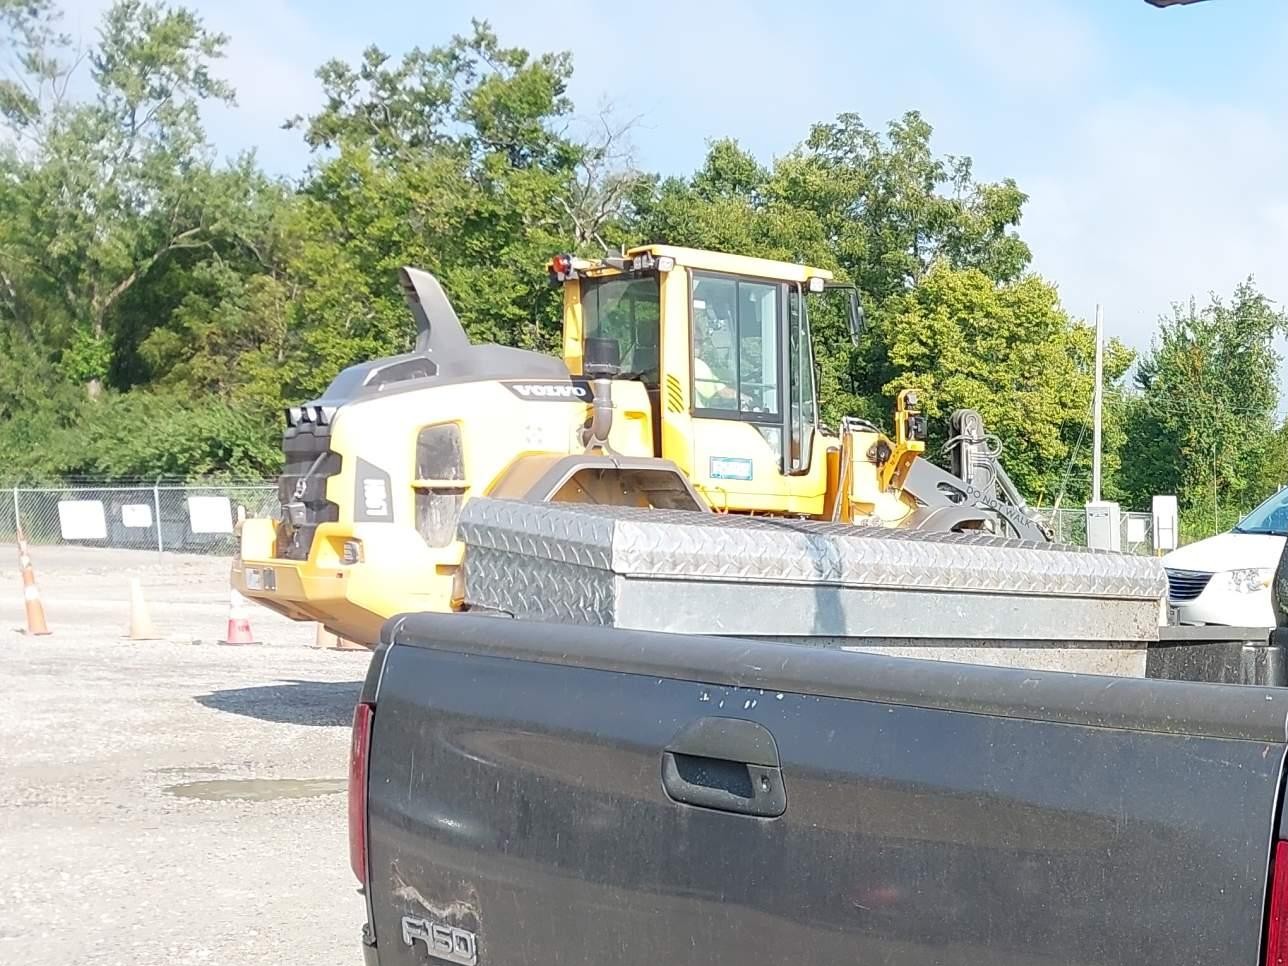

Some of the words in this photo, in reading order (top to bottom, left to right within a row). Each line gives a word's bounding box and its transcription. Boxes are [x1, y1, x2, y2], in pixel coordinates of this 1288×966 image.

[512, 384, 586, 397] VOLVO
[966, 486, 981, 498] DO
[983, 495, 1004, 511] NOT
[1006, 508, 1032, 528] WALK
